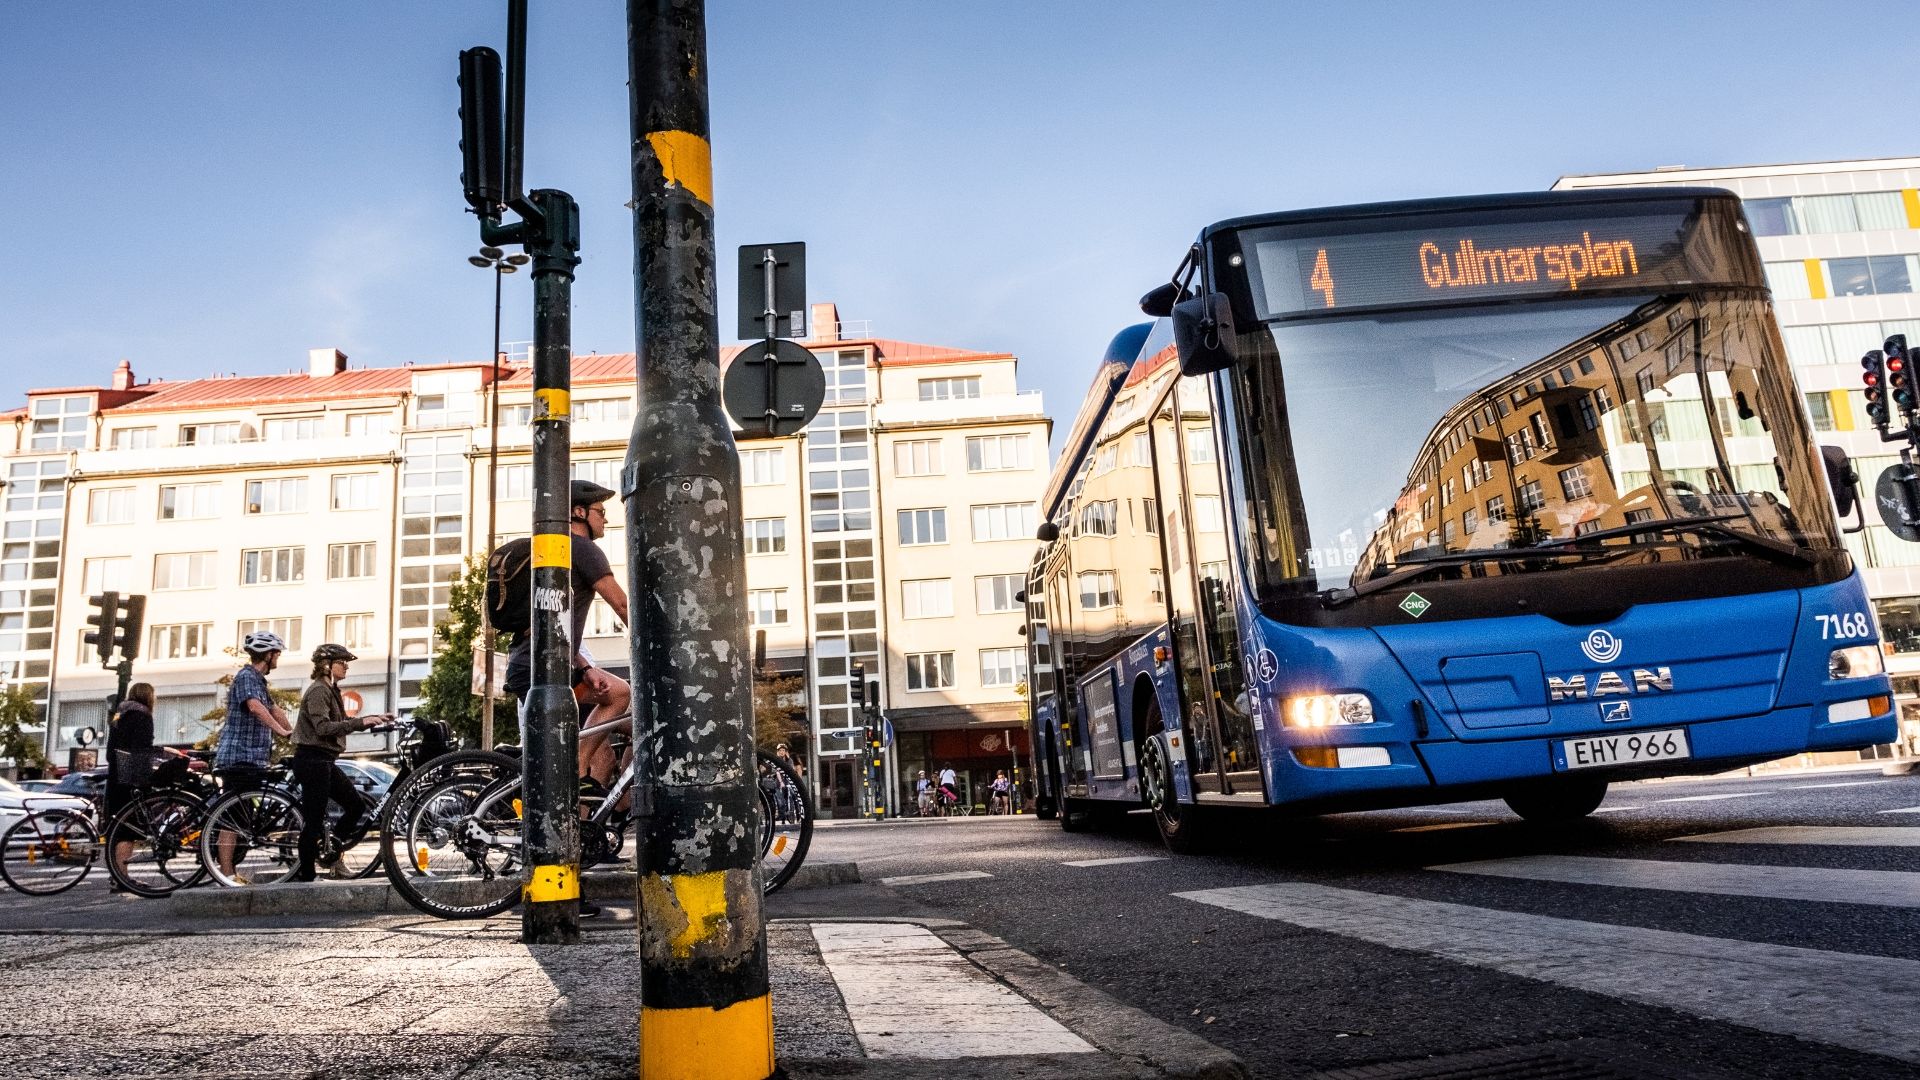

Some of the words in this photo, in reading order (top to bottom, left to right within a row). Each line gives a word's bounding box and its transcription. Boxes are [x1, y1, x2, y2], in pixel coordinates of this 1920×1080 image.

[1310, 248, 1335, 307] 4
[1419, 231, 1638, 291] Gullmarsplan
[1405, 600, 1425, 610] CNG
[1815, 612, 1869, 640] 7168
[1592, 635, 1611, 649] SL
[1547, 667, 1673, 700] MAN
[1574, 738, 1618, 765] EHY
[1627, 733, 1677, 759] 966
